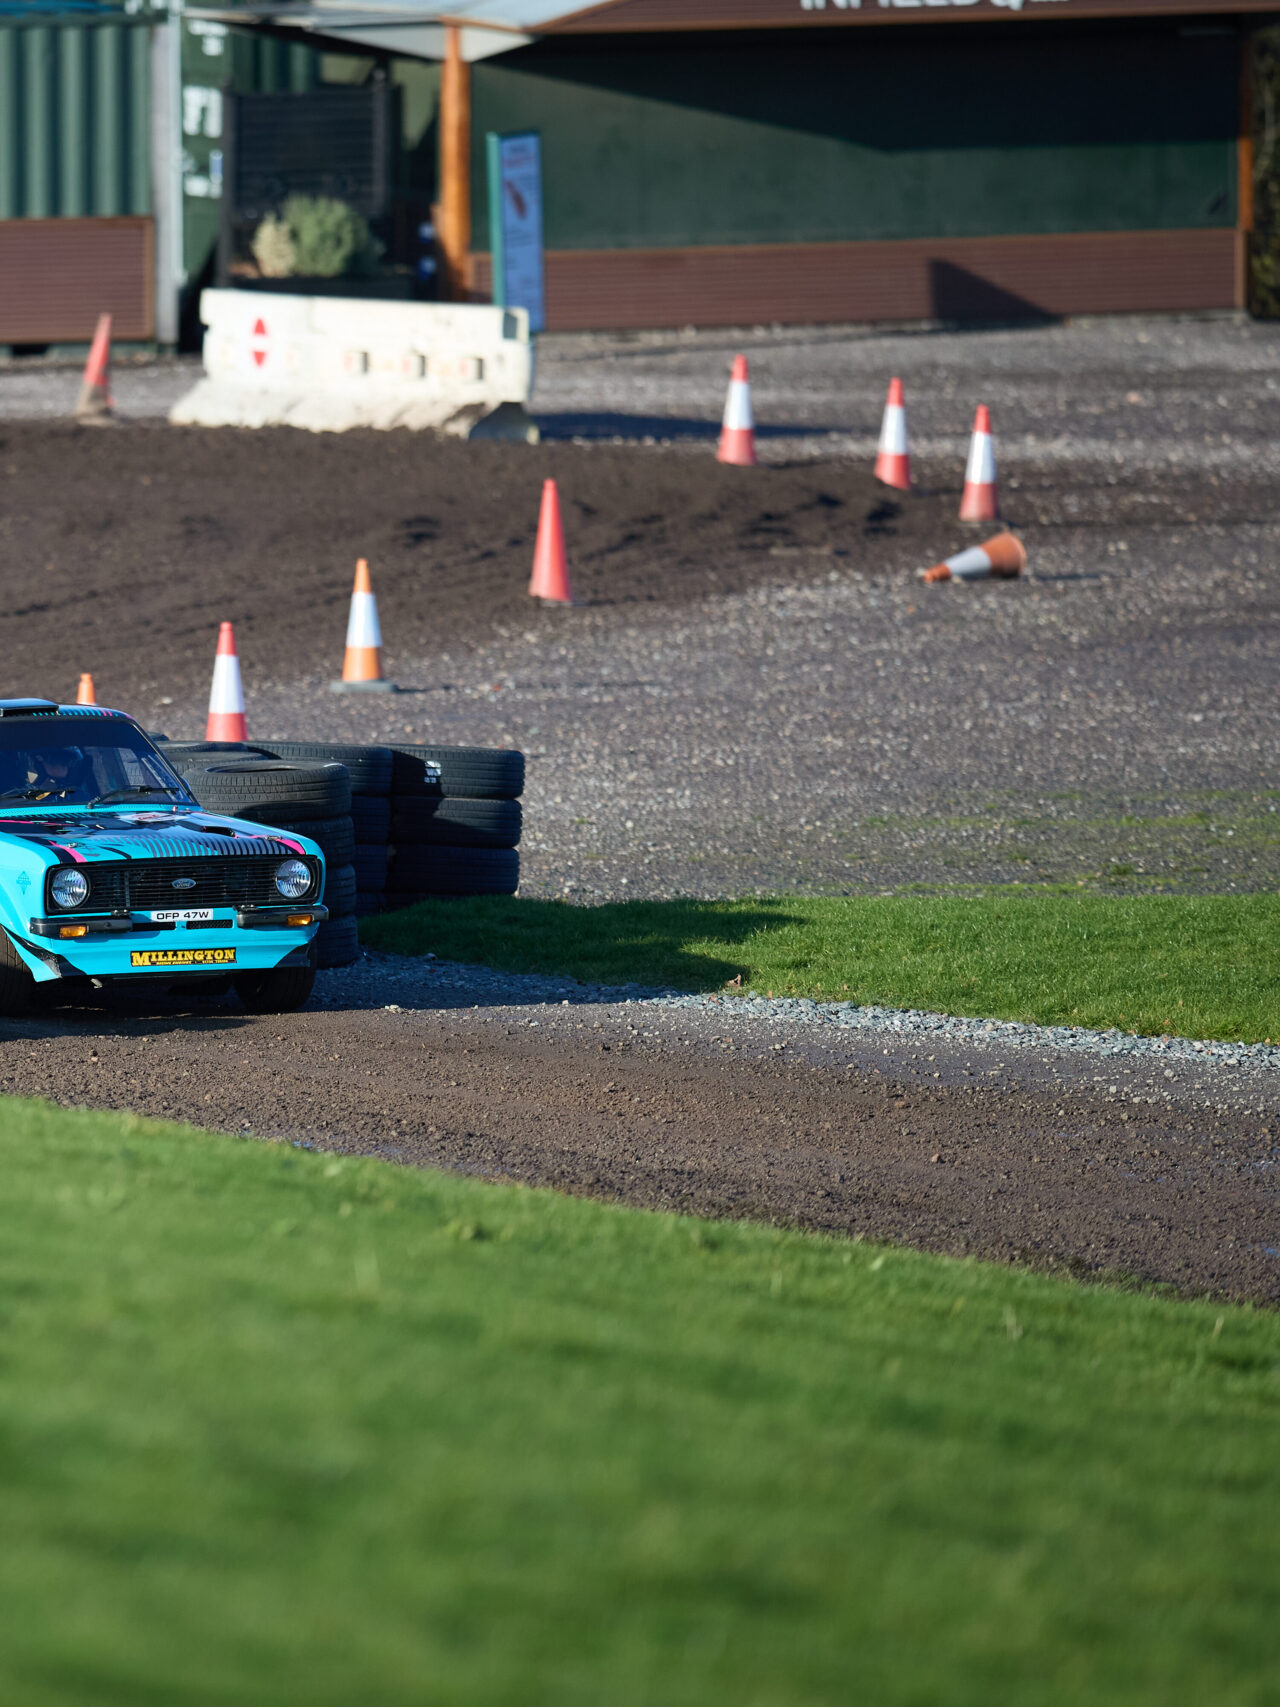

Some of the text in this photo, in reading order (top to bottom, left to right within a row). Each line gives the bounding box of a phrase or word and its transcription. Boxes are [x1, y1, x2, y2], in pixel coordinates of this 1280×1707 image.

[156, 911, 209, 920] OFP 47W
[131, 949, 235, 967] MILLINGTON
